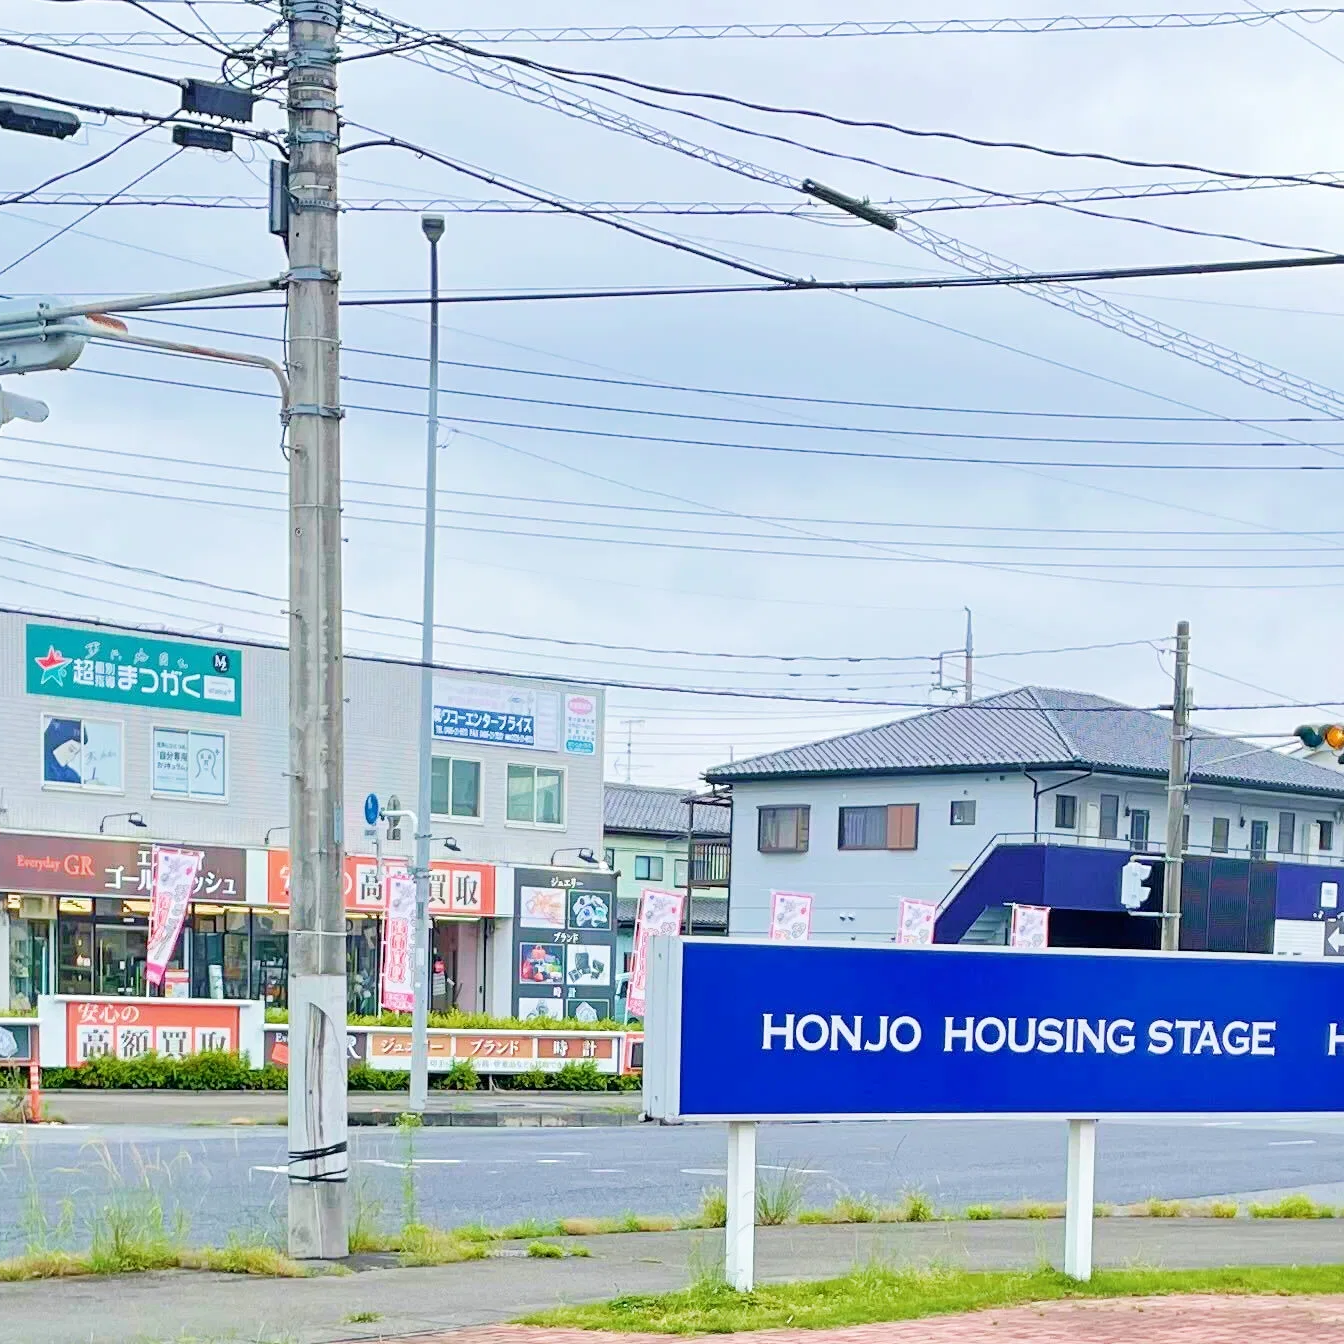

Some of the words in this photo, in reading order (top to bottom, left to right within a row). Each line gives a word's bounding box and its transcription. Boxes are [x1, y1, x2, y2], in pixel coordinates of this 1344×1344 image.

[17, 854, 60, 874] Everyday
[64, 854, 95, 876] GR
[104, 865, 236, 895] ゴールッシュ
[360, 868, 478, 906] 高買取
[553, 931, 579, 943] ブランド
[78, 1003, 140, 1024] 安心の
[762, 1013, 923, 1052] HONJO
[943, 1016, 1136, 1054] HOUSING
[1147, 1020, 1277, 1056] STAGE
[470, 1038, 519, 1057] ブランド
